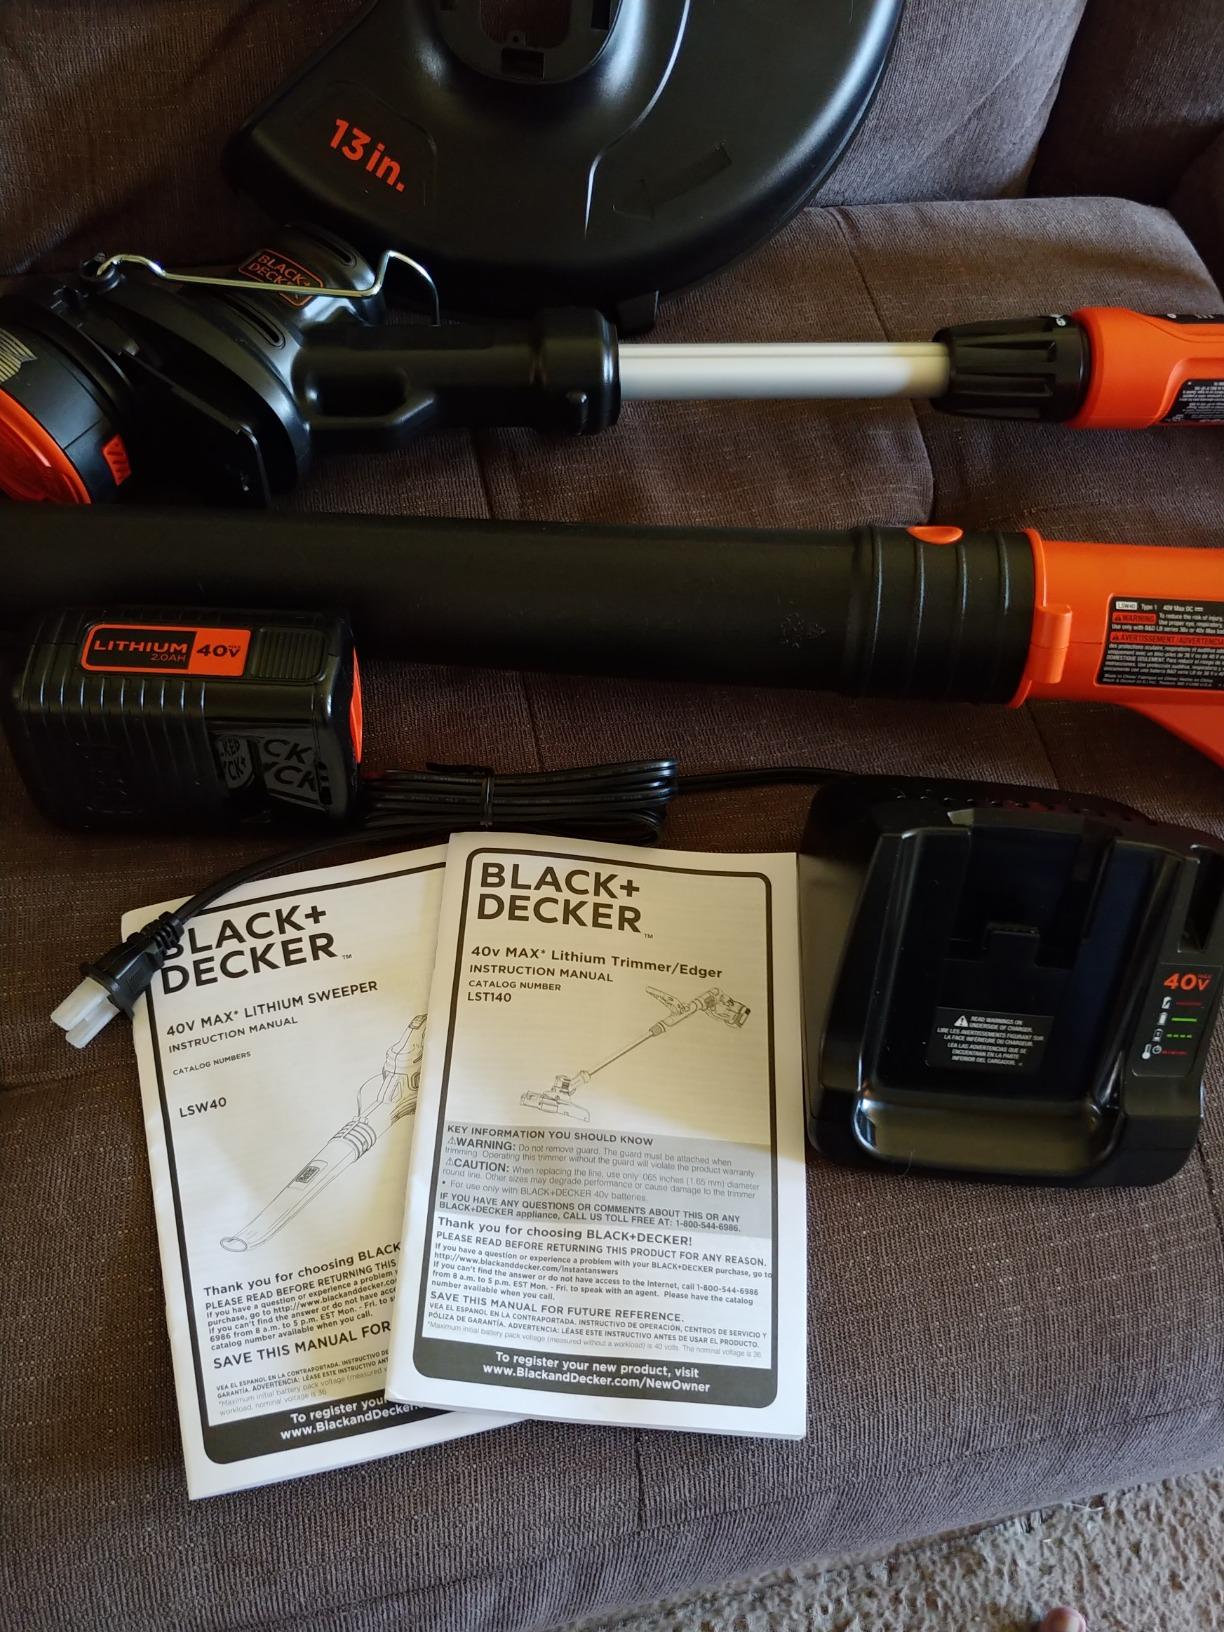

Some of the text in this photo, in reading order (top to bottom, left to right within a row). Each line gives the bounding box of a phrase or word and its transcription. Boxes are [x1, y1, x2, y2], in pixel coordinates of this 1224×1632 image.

[330, 118, 406, 192] 13 in.
[248, 263, 296, 289] DECK
[94, 640, 188, 653] LITHIUM
[480, 862, 640, 898] BLACK+
[477, 893, 641, 933] DECKER
[161, 932, 338, 995] DECKER
[470, 964, 613, 982] INSTRUCTION MANUAL
[551, 950, 606, 965] Lithium
[611, 956, 723, 979] Trimmer/Edger
[467, 991, 512, 1003] LST140
[468, 980, 561, 991] CATALOG NUMBER
[167, 1020, 195, 1036] 40V
[244, 995, 303, 1018] LITHIUM
[308, 981, 378, 1004] SWEEPER
[168, 1016, 298, 1054] INSTRUCTION MANUAL
[173, 1051, 251, 1076] CATALOG NUMBERS
[179, 1097, 227, 1118] LSW40
[448, 1125, 653, 1146] KEY INFORMATION YOU SHOULD KNOW
[456, 1137, 516, 1151] WARNING:
[454, 1158, 509, 1172] CAUTION:
[440, 1192, 740, 1222] IF YOU HAVE ANY QUESTIONS OR COMMENTS ABOUT THIS OR ANY
[440, 1202, 514, 1216] BLACK+DECKER
[516, 1210, 560, 1220] appliance,
[563, 1211, 586, 1220] CALL
[590, 1213, 602, 1221] US
[606, 1214, 628, 1223] TOLL
[632, 1216, 654, 1225] FREE
[658, 1218, 672, 1227] AT:
[438, 1217, 692, 1246] Thank you for choosing BLACK+DECKER!
[436, 1231, 766, 1267] PLEASE READ BEFORE RETURNING THIS PRODUCT FOR ANY REASON.
[444, 1245, 456, 1253] you
[458, 1245, 476, 1254] have
[484, 1249, 517, 1259] question
[530, 1254, 571, 1263] experience
[580, 1257, 612, 1265] problem
[652, 1262, 714, 1273] BLACK+DECKER
[716, 1268, 751, 1277] purchase,
[752, 1271, 762, 1279] go
[203, 1281, 243, 1297] Thank
[248, 1277, 271, 1290] you
[275, 1271, 293, 1283] for
[297, 1255, 354, 1278] choosing
[205, 1259, 397, 1310] PLEASE READ BEFORE RETURNING THIS
[432, 1280, 554, 1300] number available when you call.
[478, 1266, 492, 1275] find
[495, 1268, 506, 1277] the
[508, 1271, 536, 1280] answer
[548, 1273, 558, 1281] do
[560, 1274, 572, 1282] not
[576, 1275, 592, 1283] have
[622, 1277, 630, 1285] to
[633, 1278, 644, 1286] the
[647, 1279, 680, 1290] Internet,
[682, 1283, 694, 1291] call
[697, 1284, 758, 1295] 1-800-544-6986
[430, 1291, 684, 1322] SAVE THIS MANUAL FOR FUTURE REFERENCE.
[213, 1321, 391, 1369] SAVE THIS MANUAL FOR
[483, 1364, 711, 1392] www.BlackandDecker.com/NewOwner
[496, 1351, 699, 1378] To register your new product, visit
[290, 1412, 305, 1424] To
[310, 1402, 357, 1420] register
